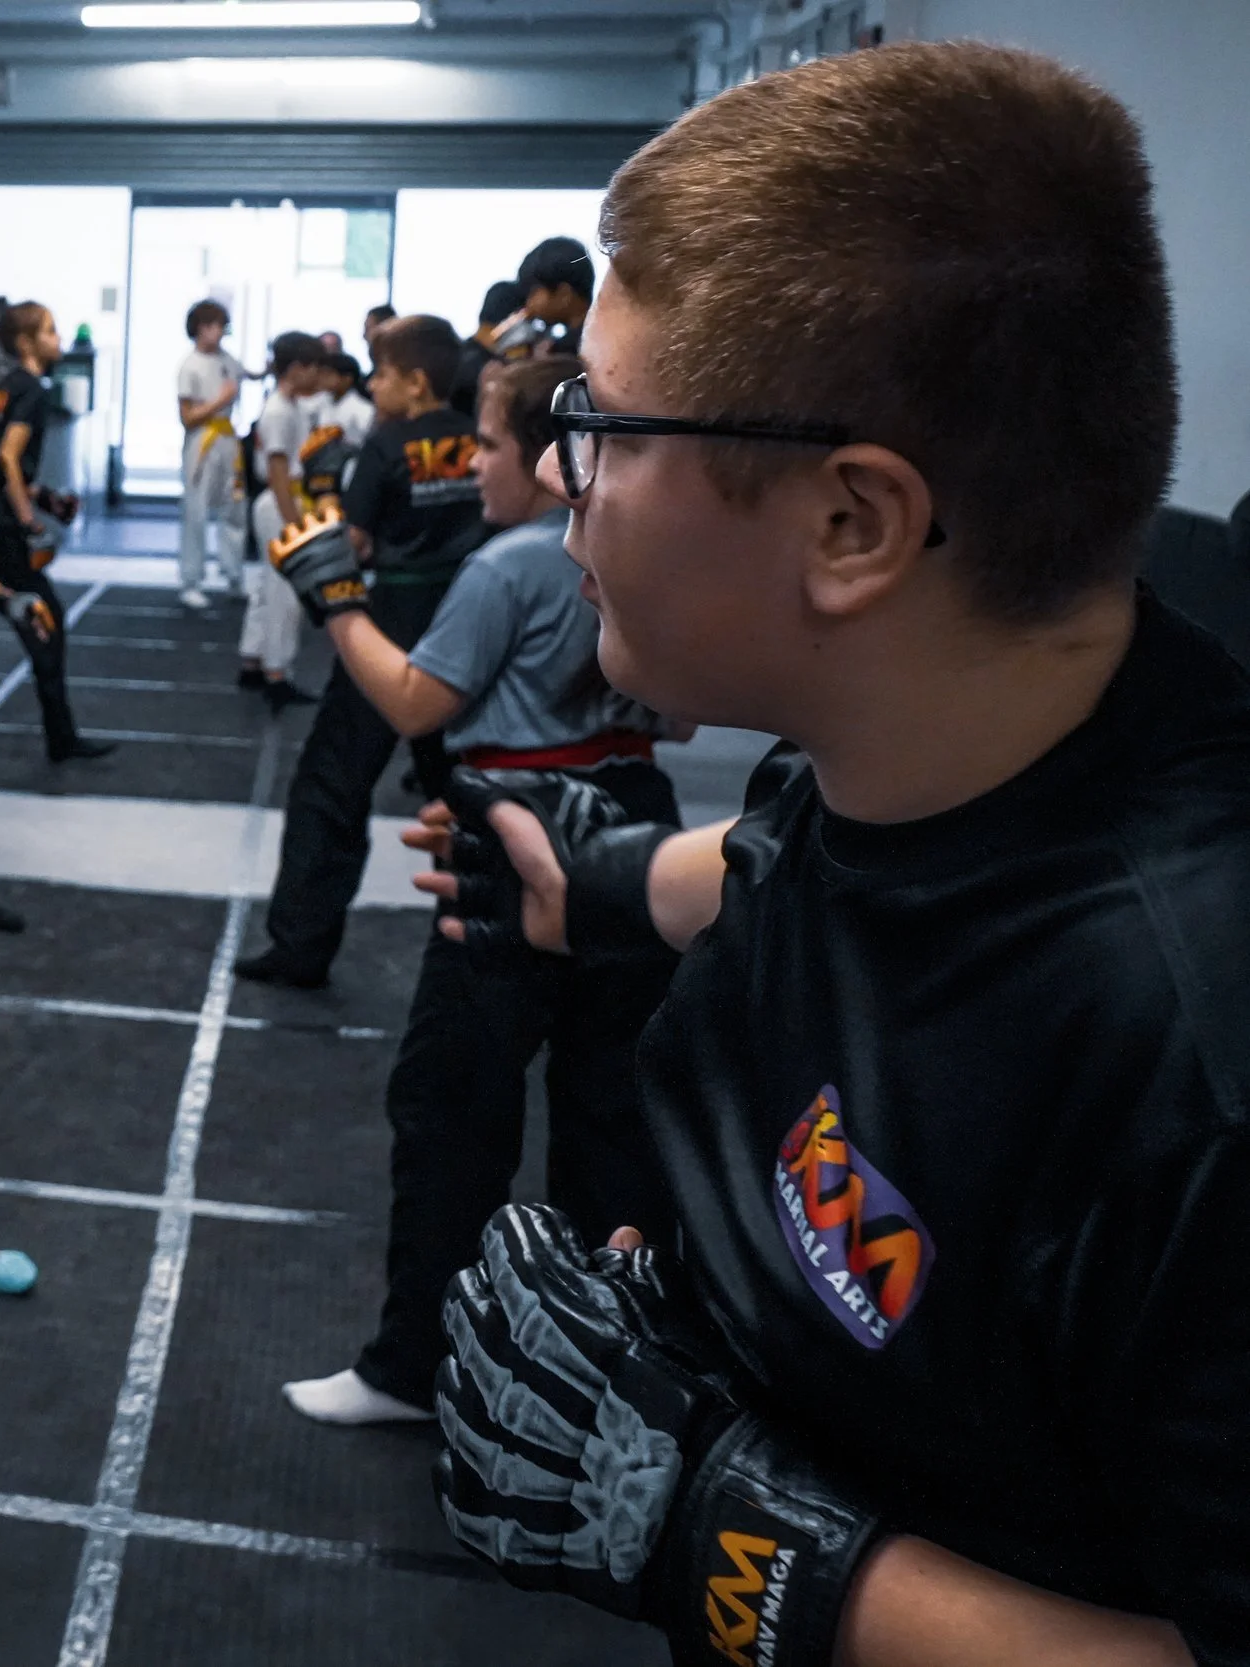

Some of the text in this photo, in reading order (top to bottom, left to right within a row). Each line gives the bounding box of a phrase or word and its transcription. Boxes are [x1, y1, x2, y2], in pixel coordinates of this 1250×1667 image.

[823, 1270, 889, 1341] ARTS
[757, 1549, 797, 1667] RAV MAGA
